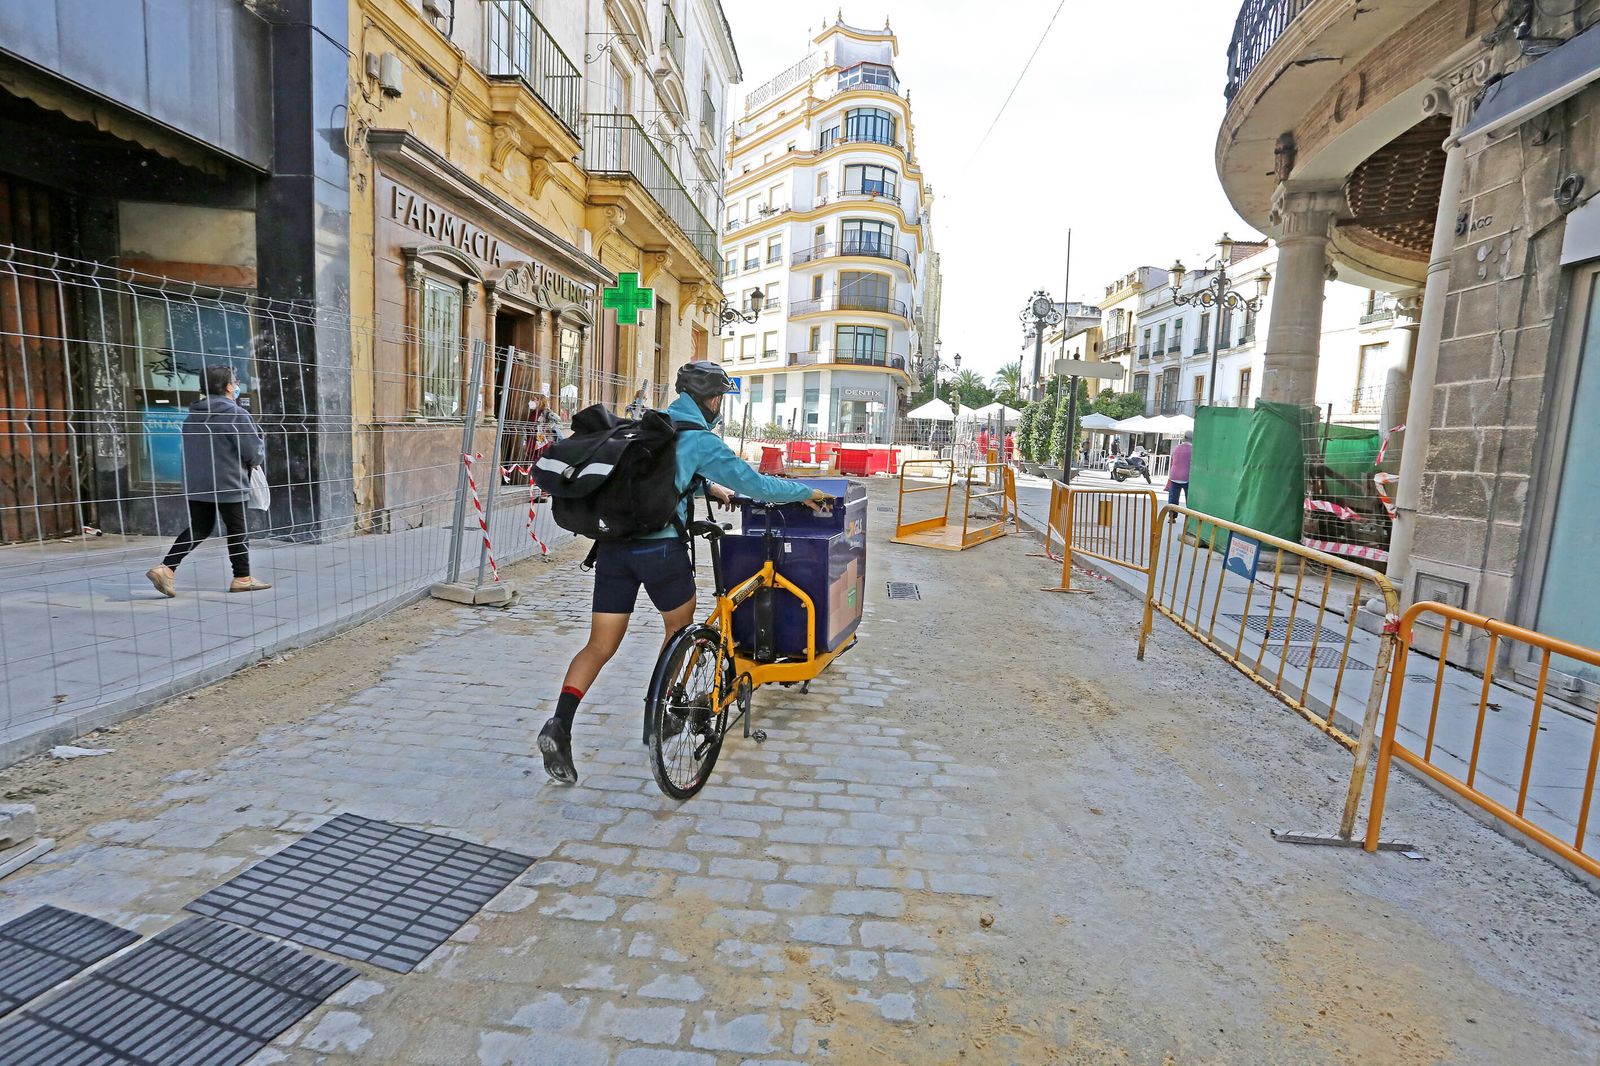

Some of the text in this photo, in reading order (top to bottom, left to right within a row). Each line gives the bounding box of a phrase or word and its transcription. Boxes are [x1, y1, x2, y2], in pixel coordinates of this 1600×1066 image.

[391, 185, 589, 310] FARMACIA FIGUEROA
[844, 389, 881, 397] DENTIX
